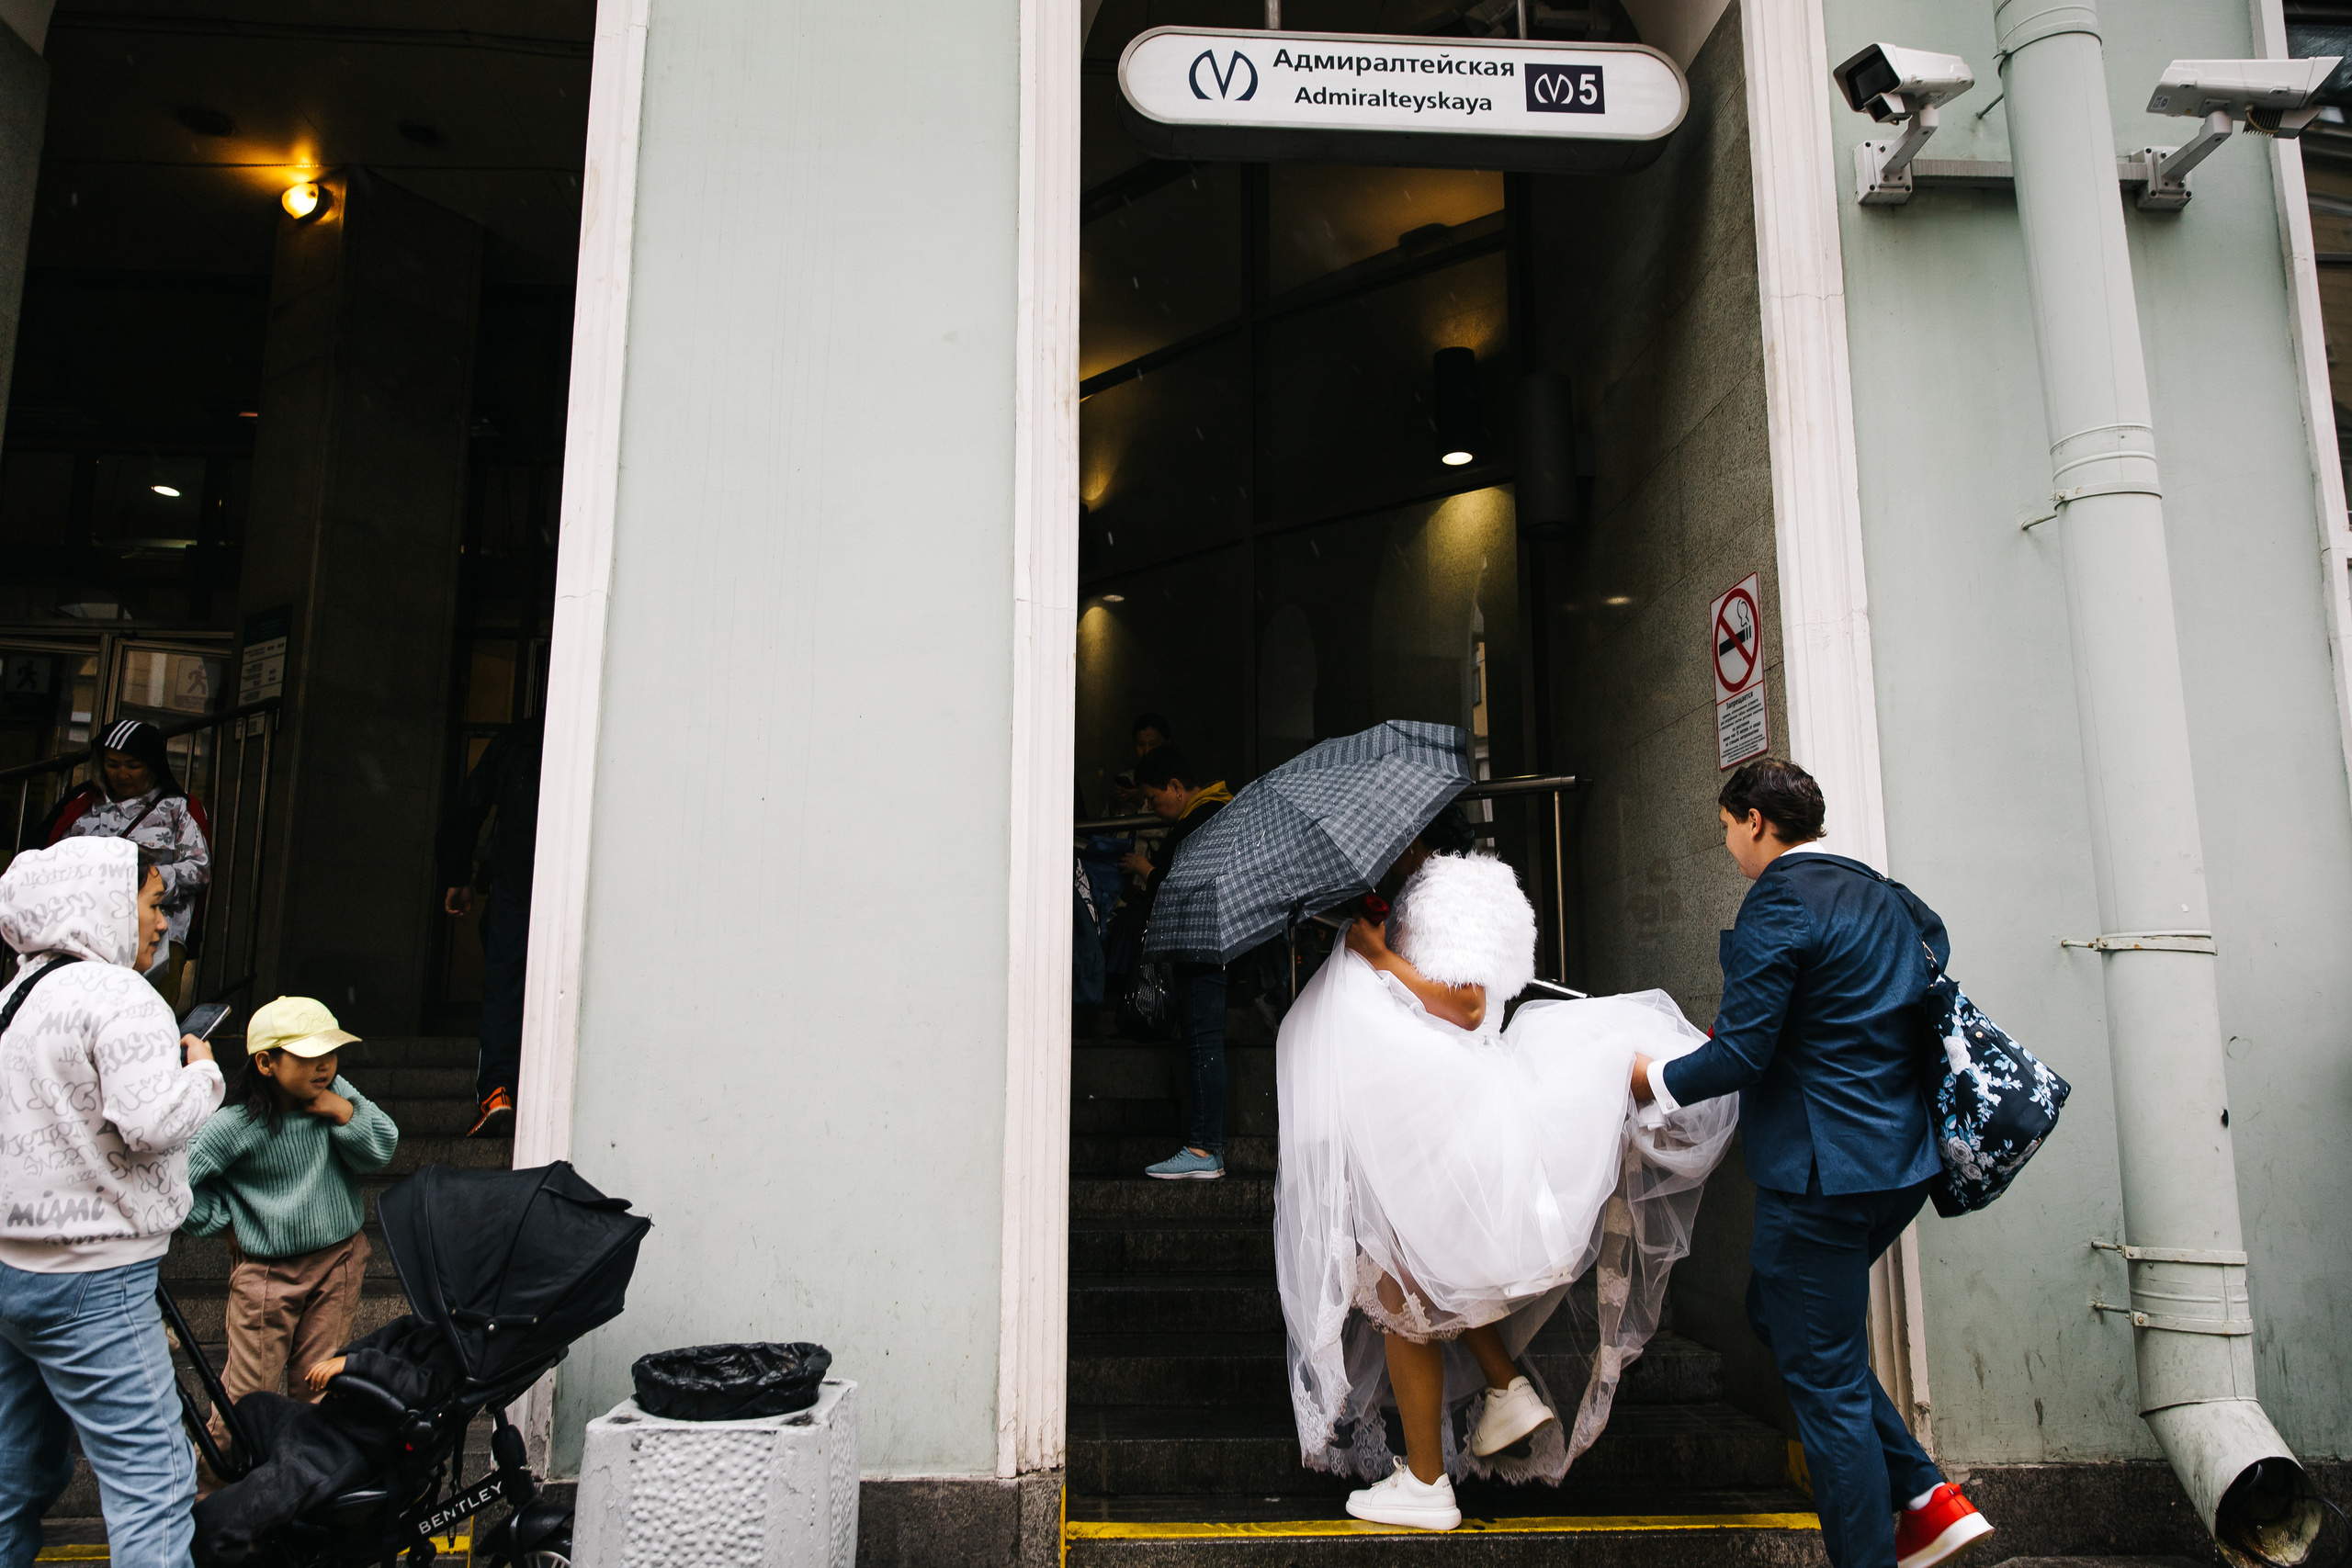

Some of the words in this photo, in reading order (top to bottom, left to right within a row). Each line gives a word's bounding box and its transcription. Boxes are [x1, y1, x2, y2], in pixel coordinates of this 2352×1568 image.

[1272, 48, 1515, 77] Адмиралтейская
[1294, 86, 1493, 116] Admiralteyskaya
[1578, 73, 1598, 106] 5
[1726, 691, 1753, 710] Запрещается
[418, 1481, 503, 1535] BENTLEY
